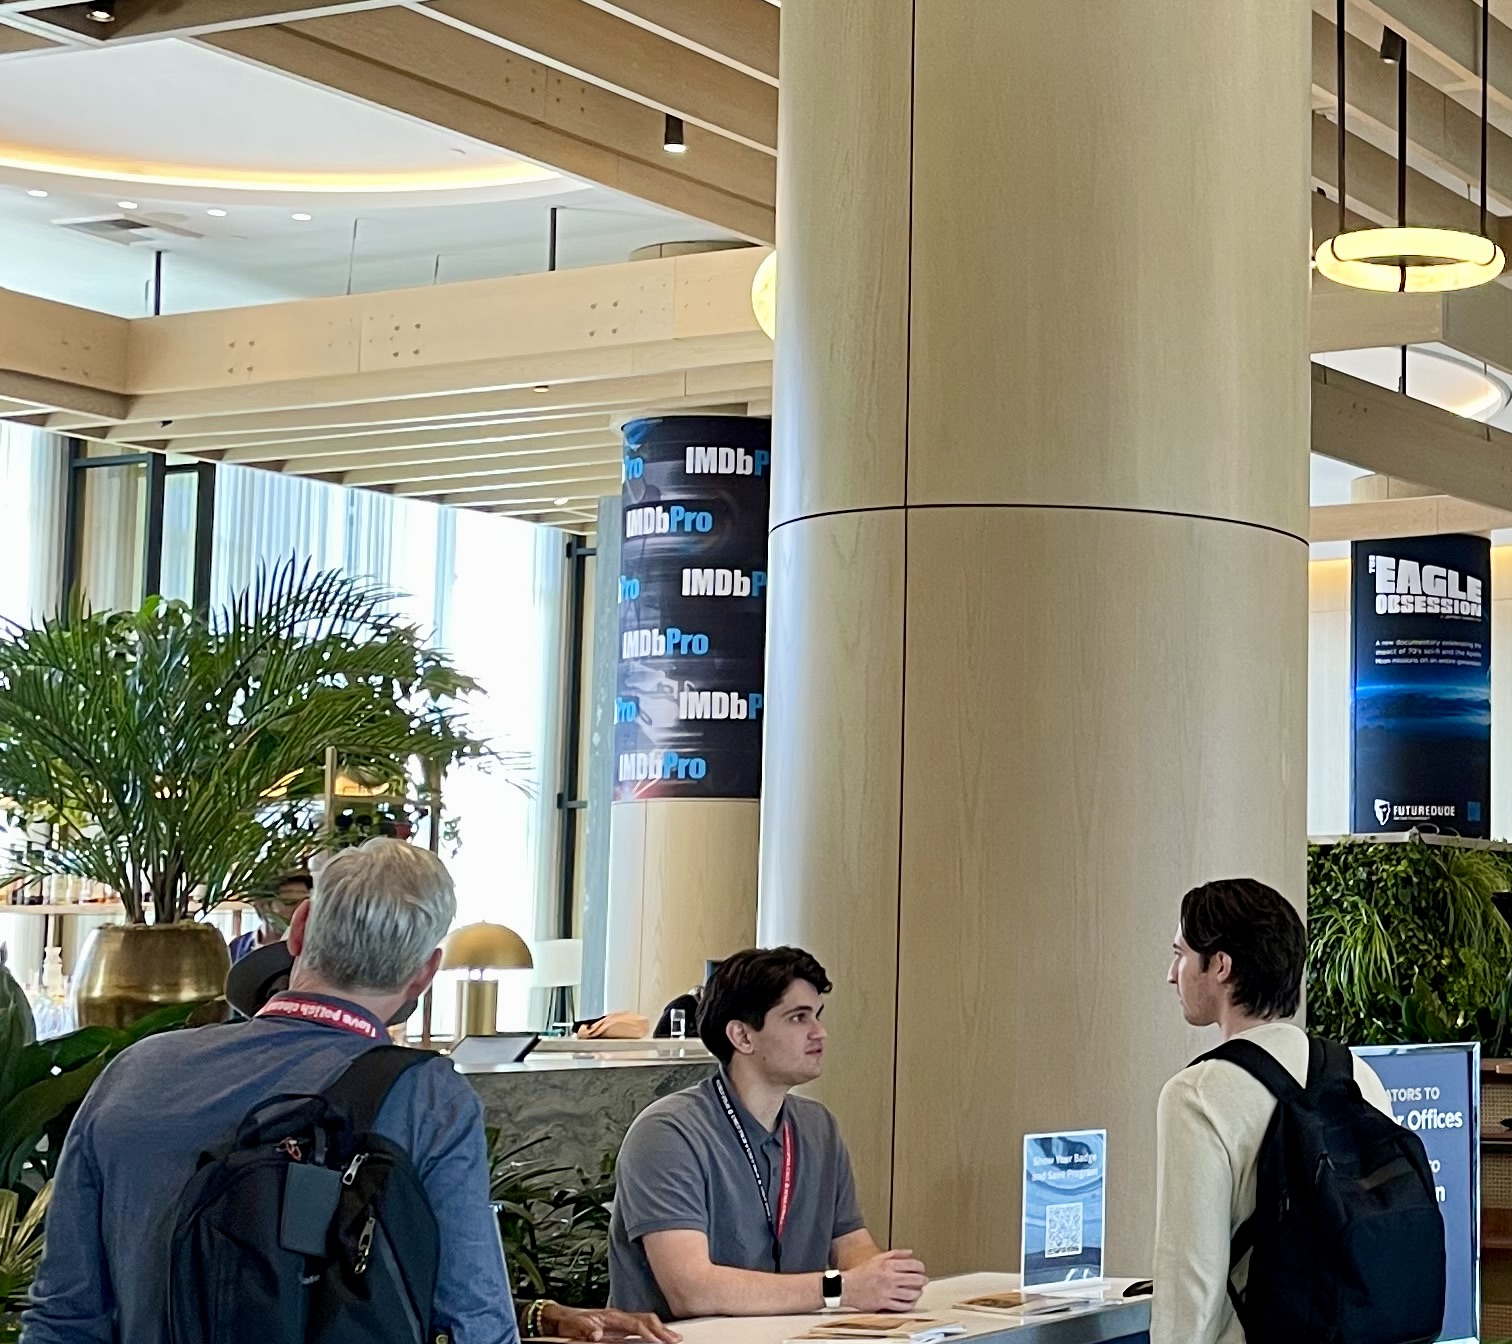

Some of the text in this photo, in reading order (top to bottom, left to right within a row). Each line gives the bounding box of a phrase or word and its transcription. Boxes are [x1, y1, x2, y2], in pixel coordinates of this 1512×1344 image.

[626, 505, 713, 538] IMDbPro
[1375, 555, 1482, 605] EAGLE
[1375, 594, 1482, 617] OBSESSION
[622, 627, 709, 659] IMDbPro
[619, 751, 706, 781] IMDbPro
[1393, 805, 1456, 817] FUTUREDUDE
[1423, 1086, 1440, 1100] TO
[1407, 1108, 1463, 1130] Offices
